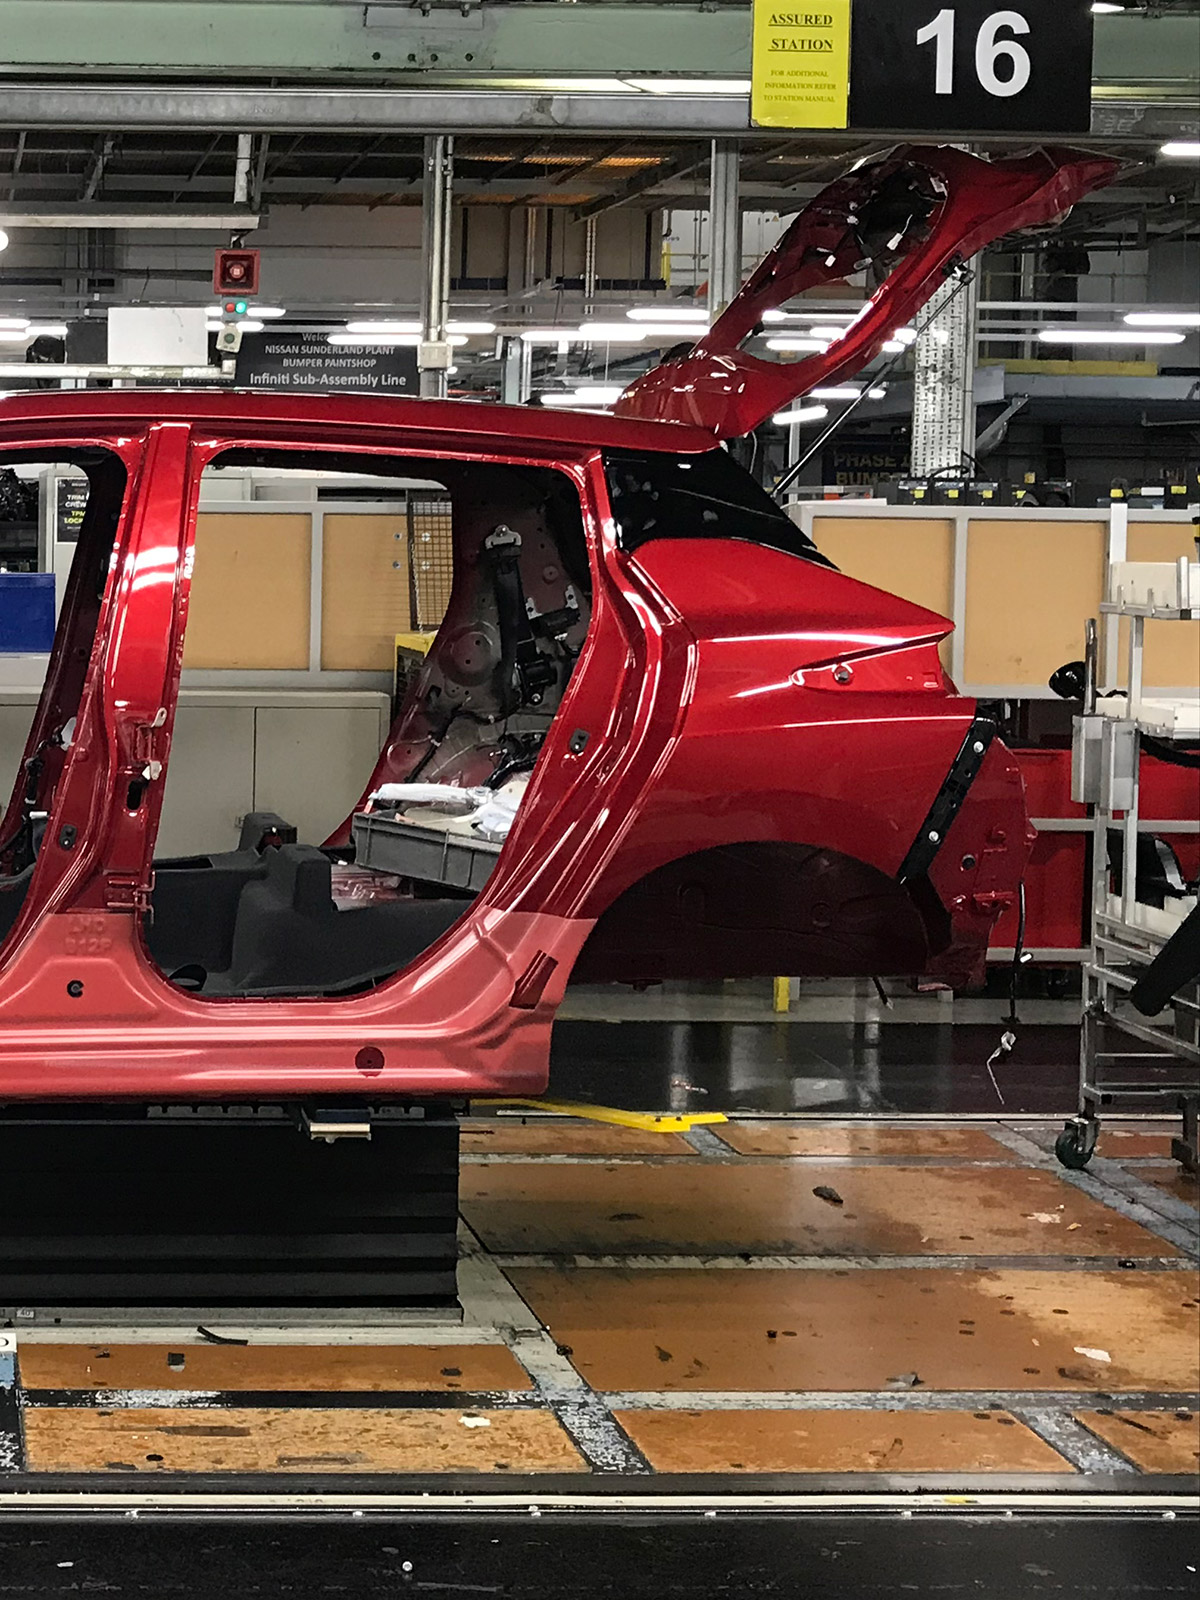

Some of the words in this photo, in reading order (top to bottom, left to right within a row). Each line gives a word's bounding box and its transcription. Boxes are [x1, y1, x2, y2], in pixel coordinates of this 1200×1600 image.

[768, 14, 833, 27] ASSURED
[770, 38, 834, 51] STATION
[916, 9, 1031, 97] 16
[302, 332, 329, 342] Welc
[265, 345, 300, 354] NISSAN
[301, 345, 363, 355] SUNDERLAND
[365, 346, 395, 355] PLANT
[282, 359, 323, 368] BUMPER
[324, 359, 377, 369] PAINTSHOP
[250, 373, 290, 385] Infiniti
[292, 373, 378, 387] Sub-Assembly
[381, 374, 407, 386] Line
